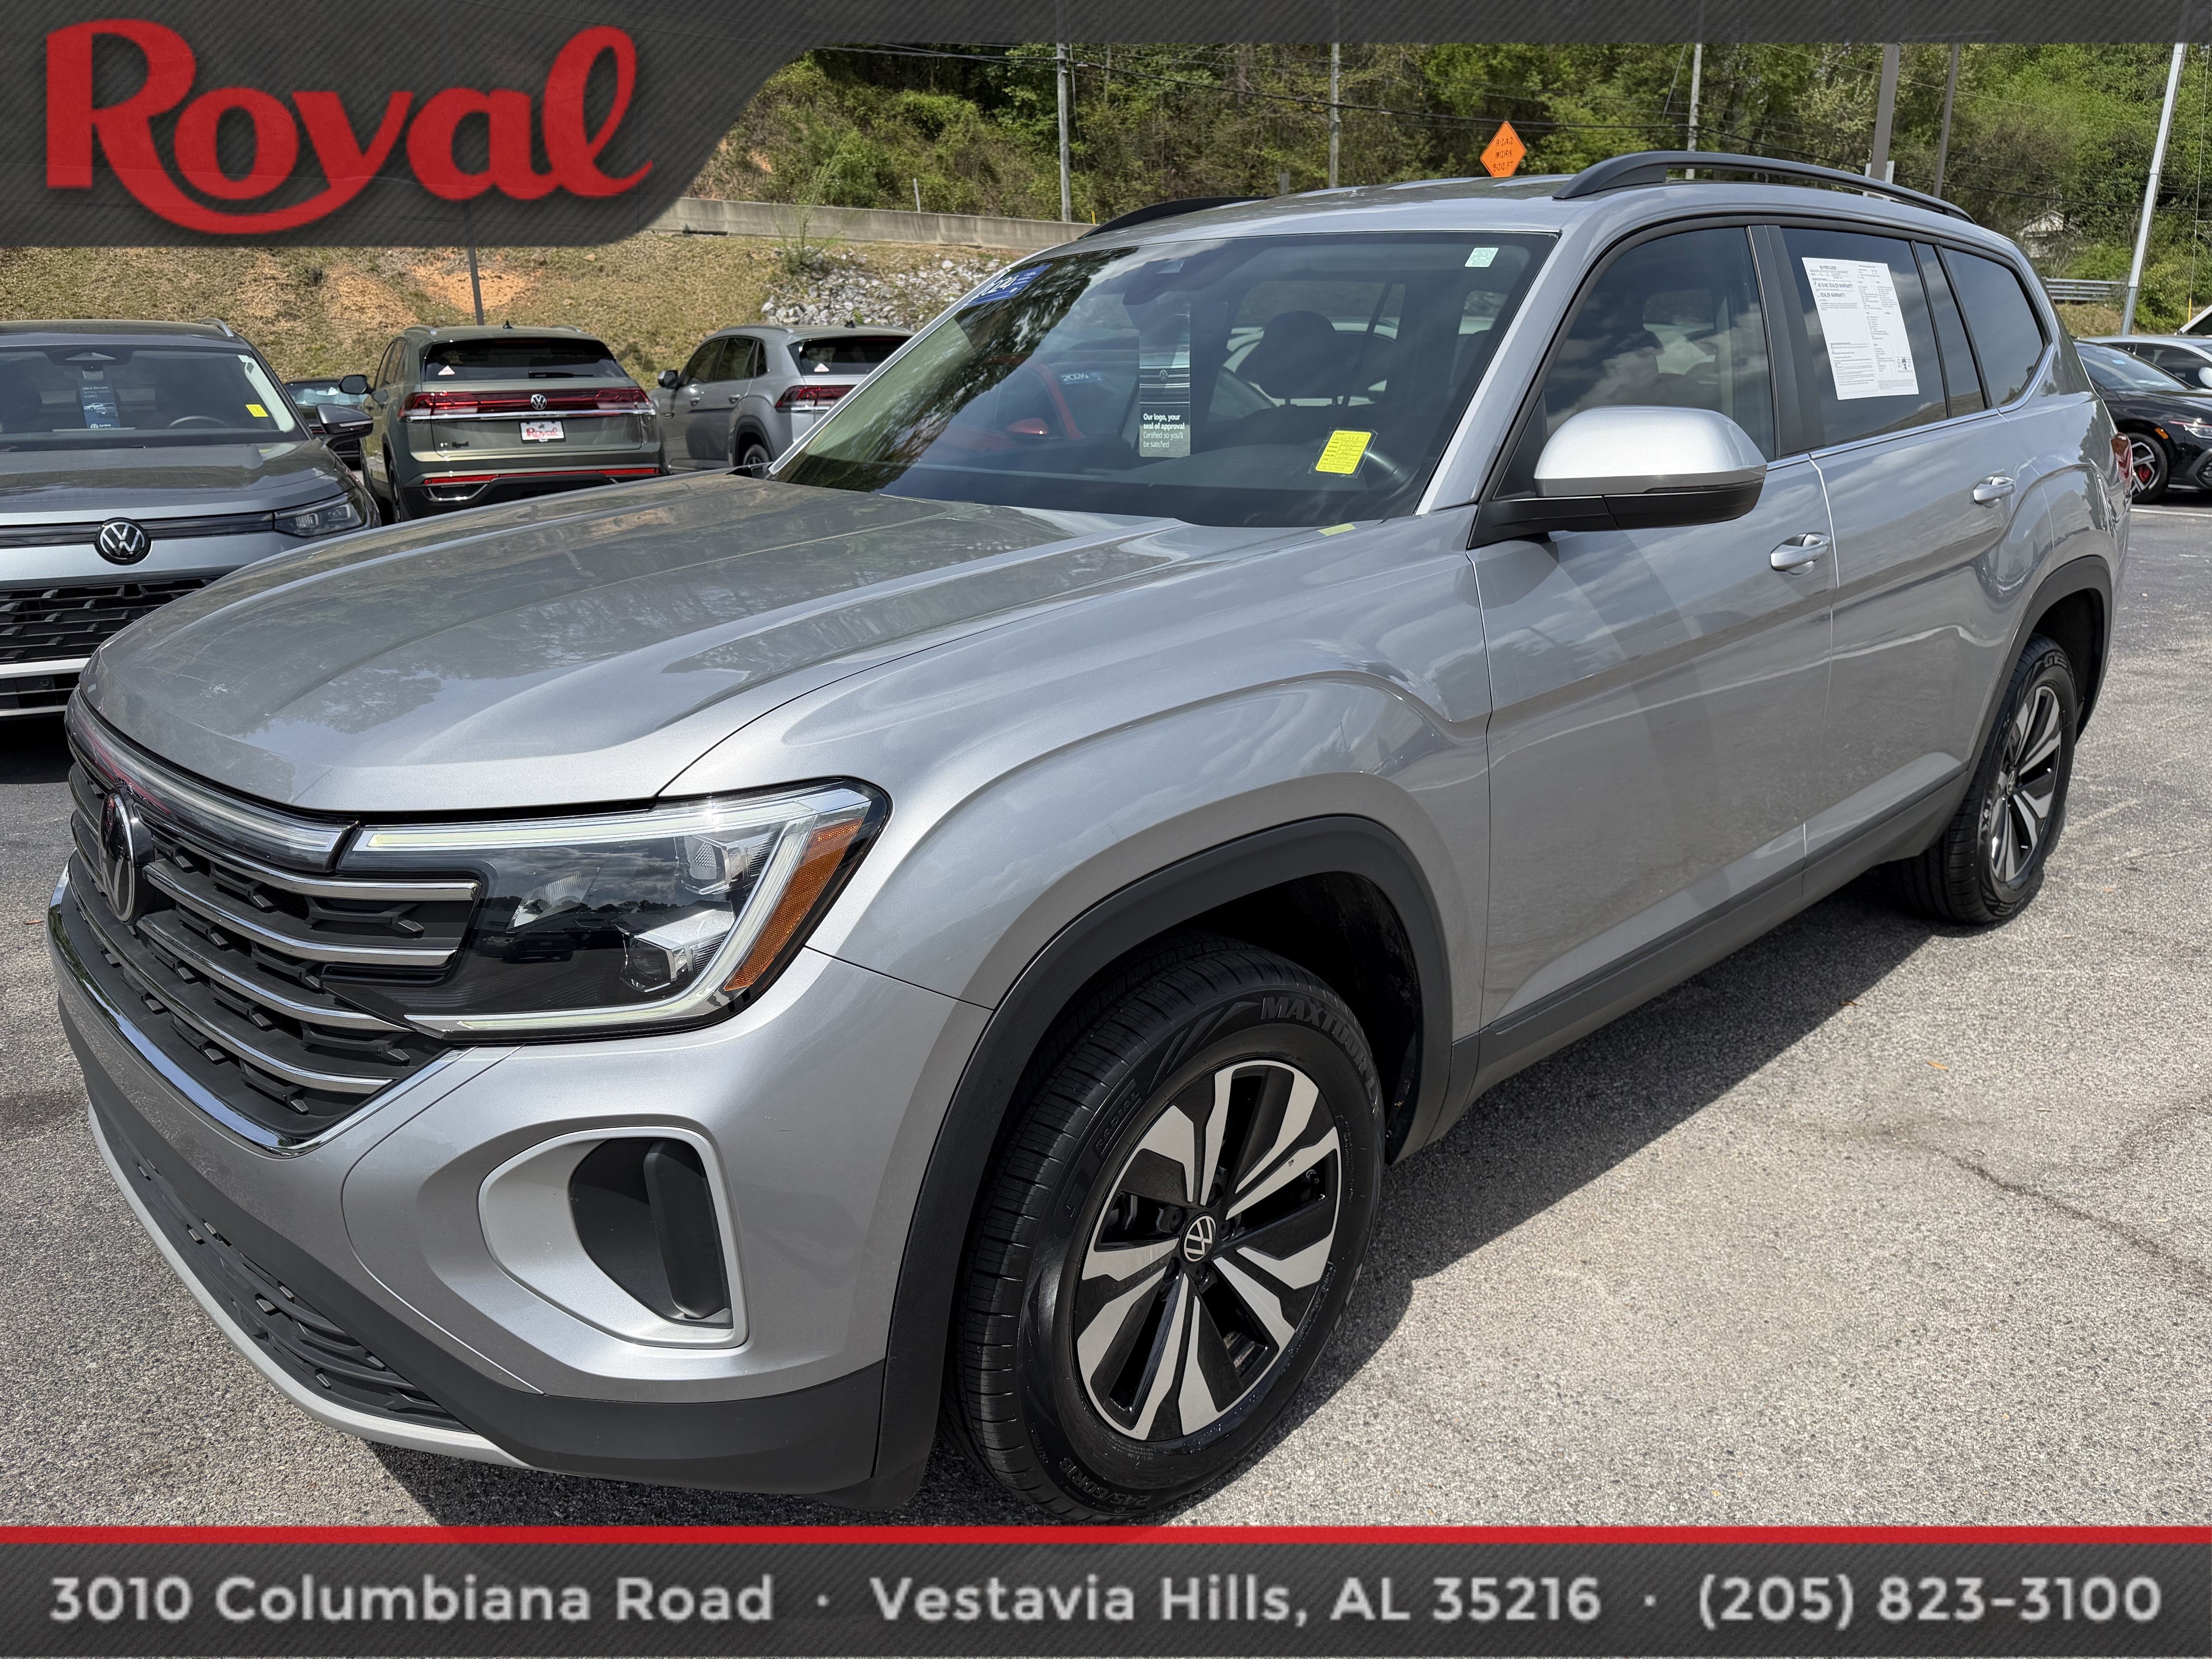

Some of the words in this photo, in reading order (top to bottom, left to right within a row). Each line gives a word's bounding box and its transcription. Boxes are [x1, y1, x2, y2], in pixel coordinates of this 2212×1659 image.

[1496, 137, 1515, 146] ROAD
[1154, 413, 1167, 422] logo,
[1161, 422, 1185, 431] approval
[526, 427, 558, 438] Royal
[1261, 996, 1371, 1077] MAXTOUR
